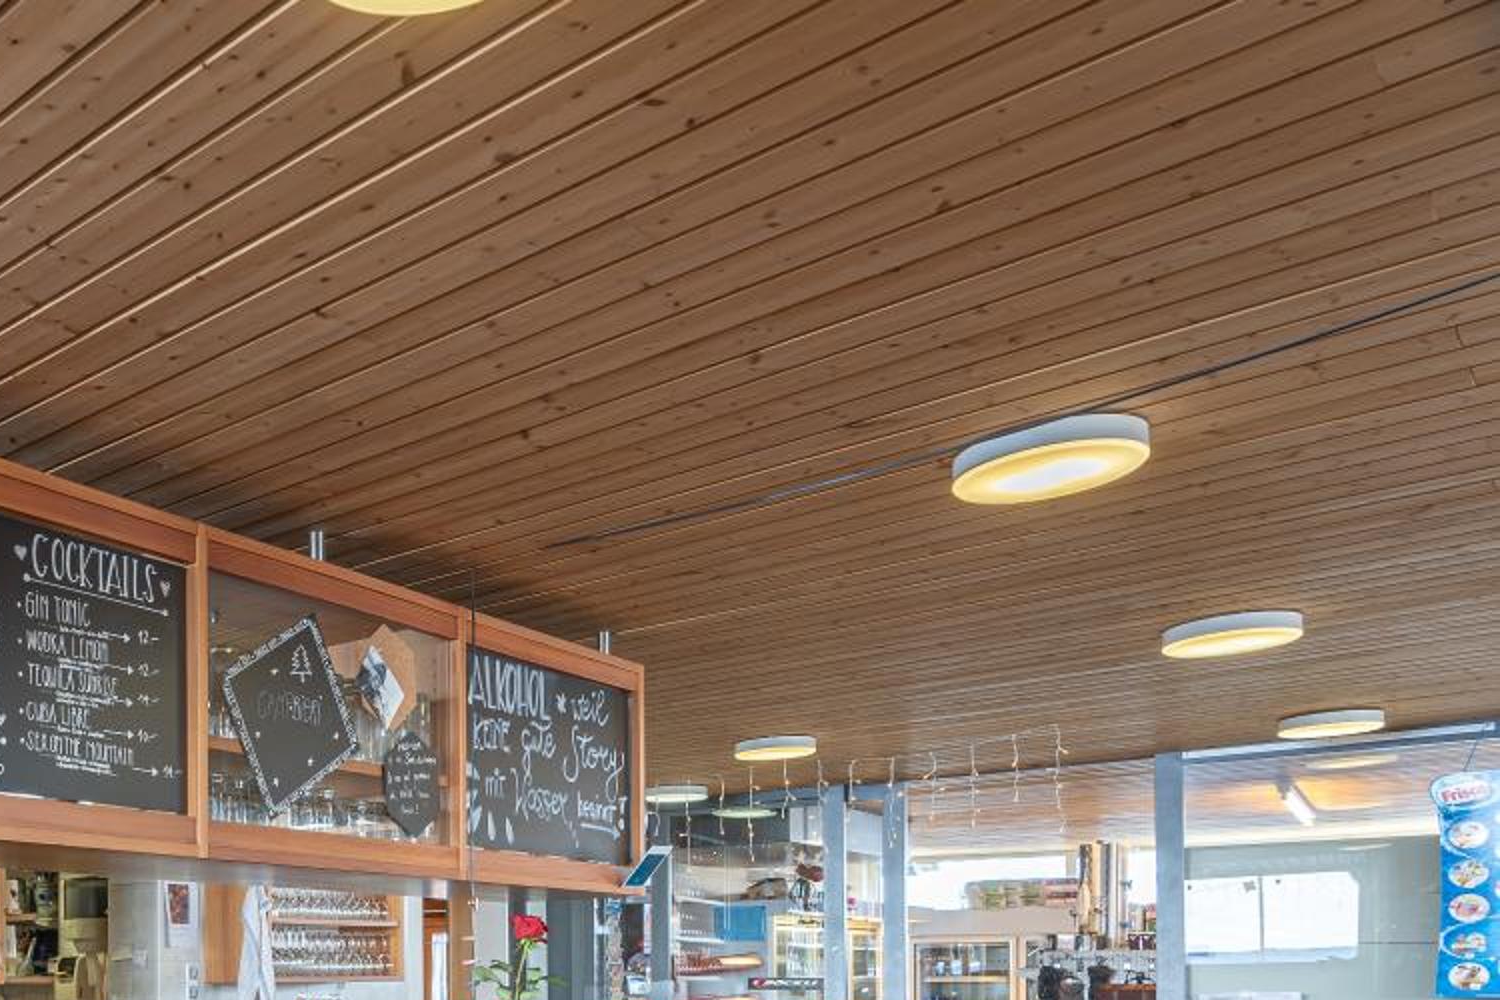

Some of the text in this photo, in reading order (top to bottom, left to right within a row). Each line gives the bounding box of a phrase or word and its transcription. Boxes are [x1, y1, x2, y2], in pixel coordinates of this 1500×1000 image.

[31, 533, 158, 603] COCKTAILS
[467, 655, 551, 721] ALKOHOL
[563, 725, 625, 801] Story
